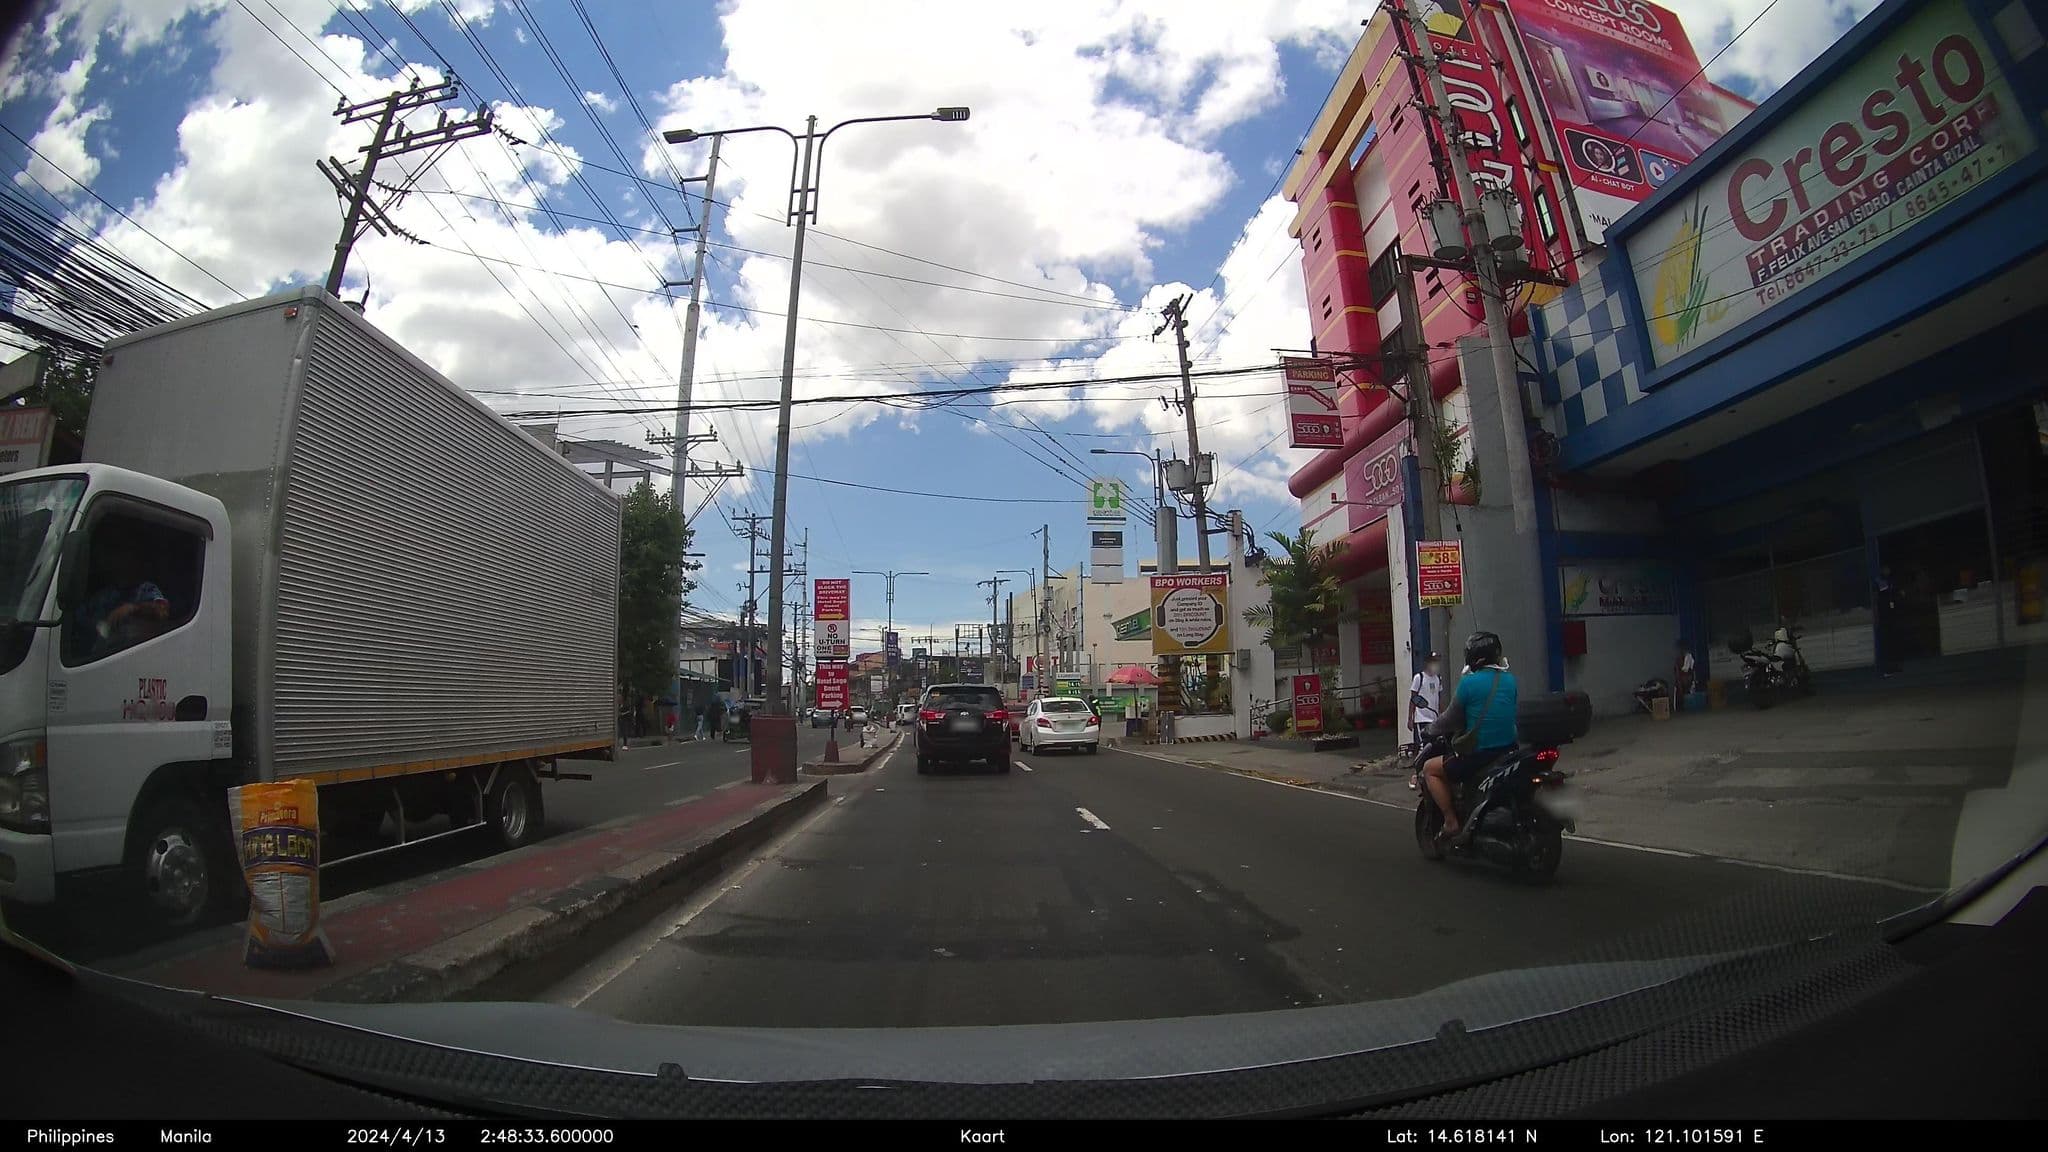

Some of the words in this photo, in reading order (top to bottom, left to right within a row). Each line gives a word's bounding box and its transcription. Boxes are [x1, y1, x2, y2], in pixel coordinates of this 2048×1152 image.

[1544, 0, 1617, 28] CONCEPT
[1619, 20, 1673, 51] ROOMS
[1727, 33, 1986, 242] Cresto
[1896, 158, 1943, 196] CAINTA
[1942, 134, 1980, 167] RIZAL
[1621, 182, 1635, 192] BOT
[1751, 168, 1890, 266] TRADING
[1292, 368, 1329, 380] PARKING
[1155, 578, 1174, 587] BPO
[1176, 576, 1223, 587] WORKERS
[138, 677, 167, 701] PLASTIC
